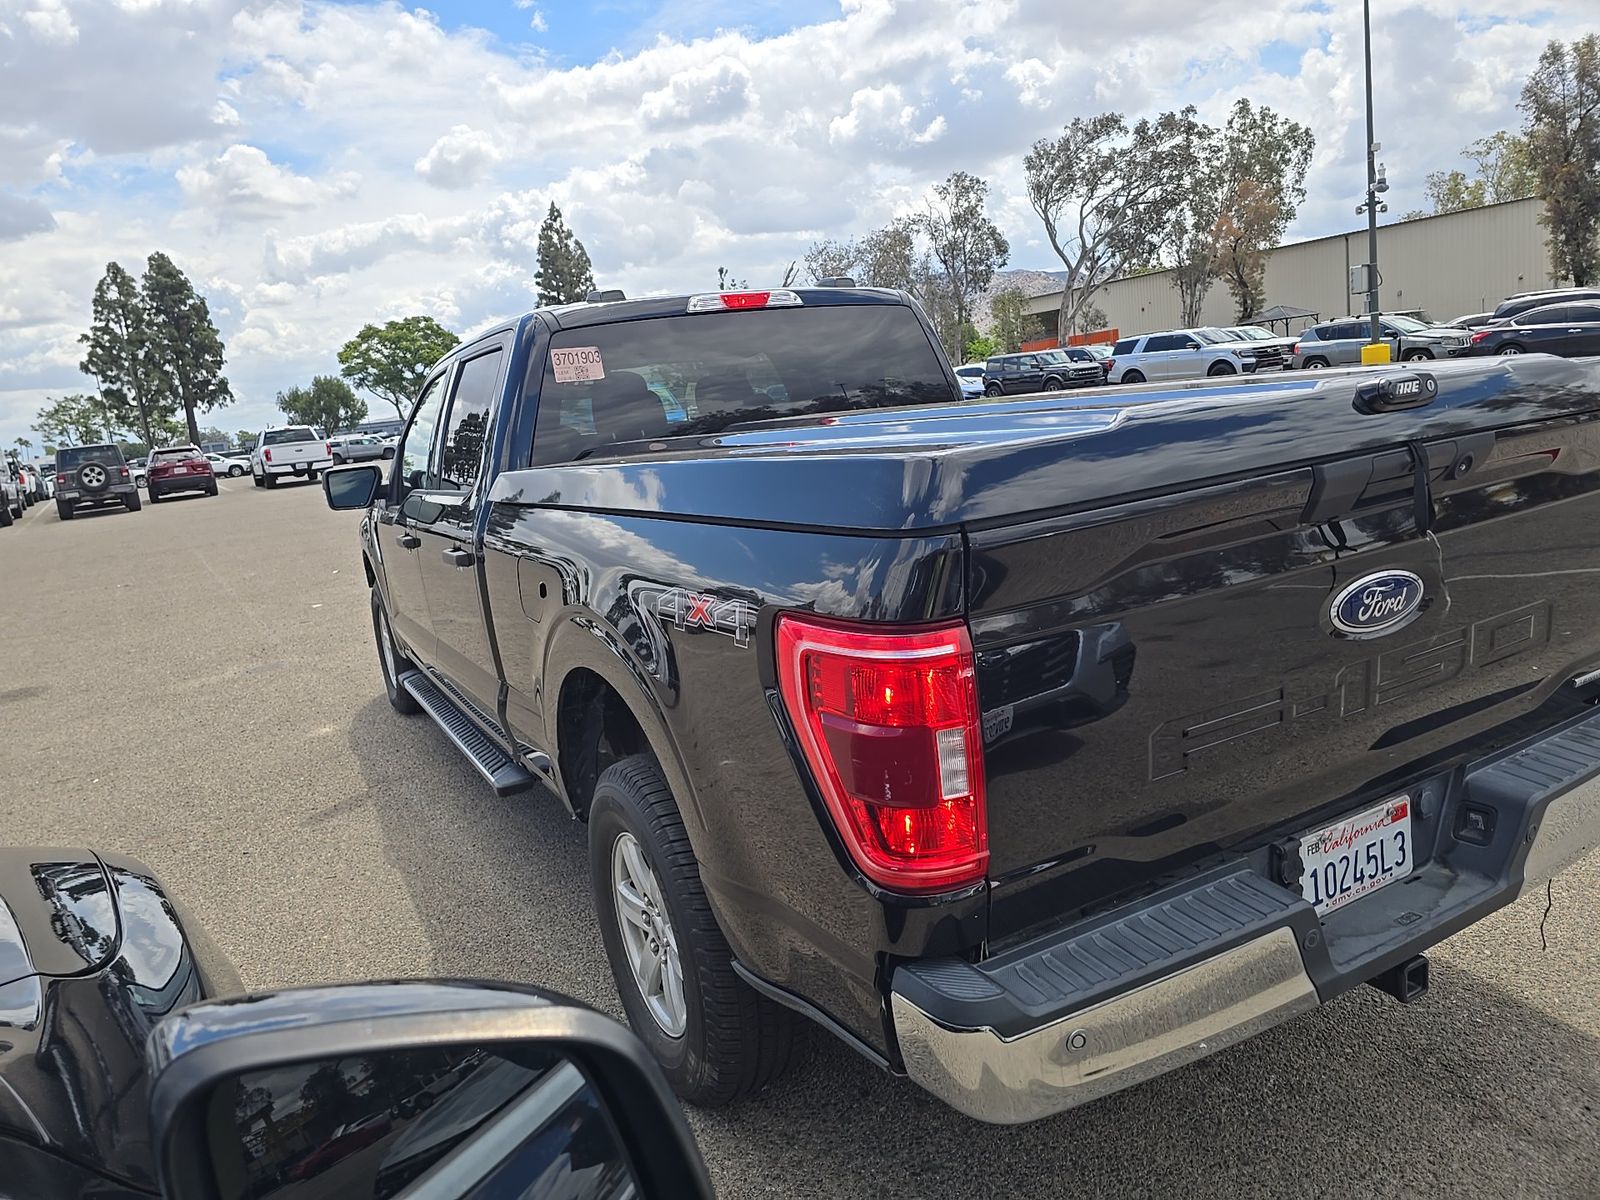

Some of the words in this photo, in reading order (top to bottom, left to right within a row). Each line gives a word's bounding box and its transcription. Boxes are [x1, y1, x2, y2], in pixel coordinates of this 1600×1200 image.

[553, 350, 601, 366] 3701903
[1396, 380, 1420, 395] ARE
[1358, 583, 1408, 621] Ford
[1307, 841, 1321, 857] FEB
[1323, 817, 1390, 853] California
[1310, 831, 1406, 907] 10245L3
[1331, 874, 1388, 906] dmv.ca.gov
